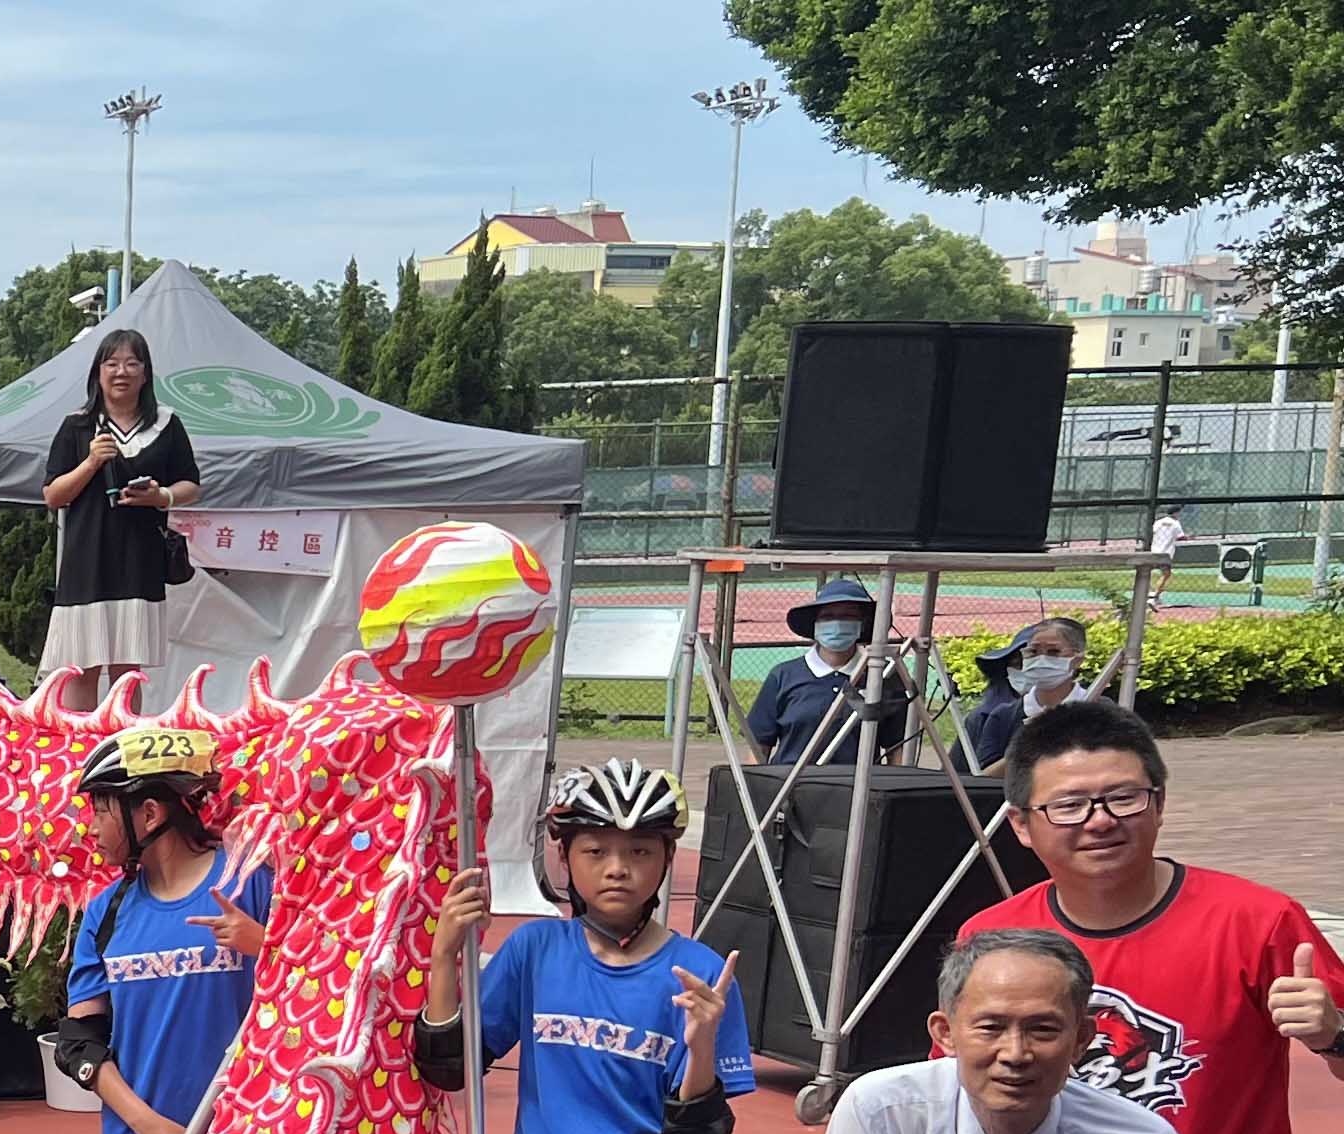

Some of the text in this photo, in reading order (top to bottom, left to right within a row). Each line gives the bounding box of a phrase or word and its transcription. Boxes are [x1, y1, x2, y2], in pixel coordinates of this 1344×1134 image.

[216, 526, 324, 556] 音控區
[139, 734, 195, 761] 223
